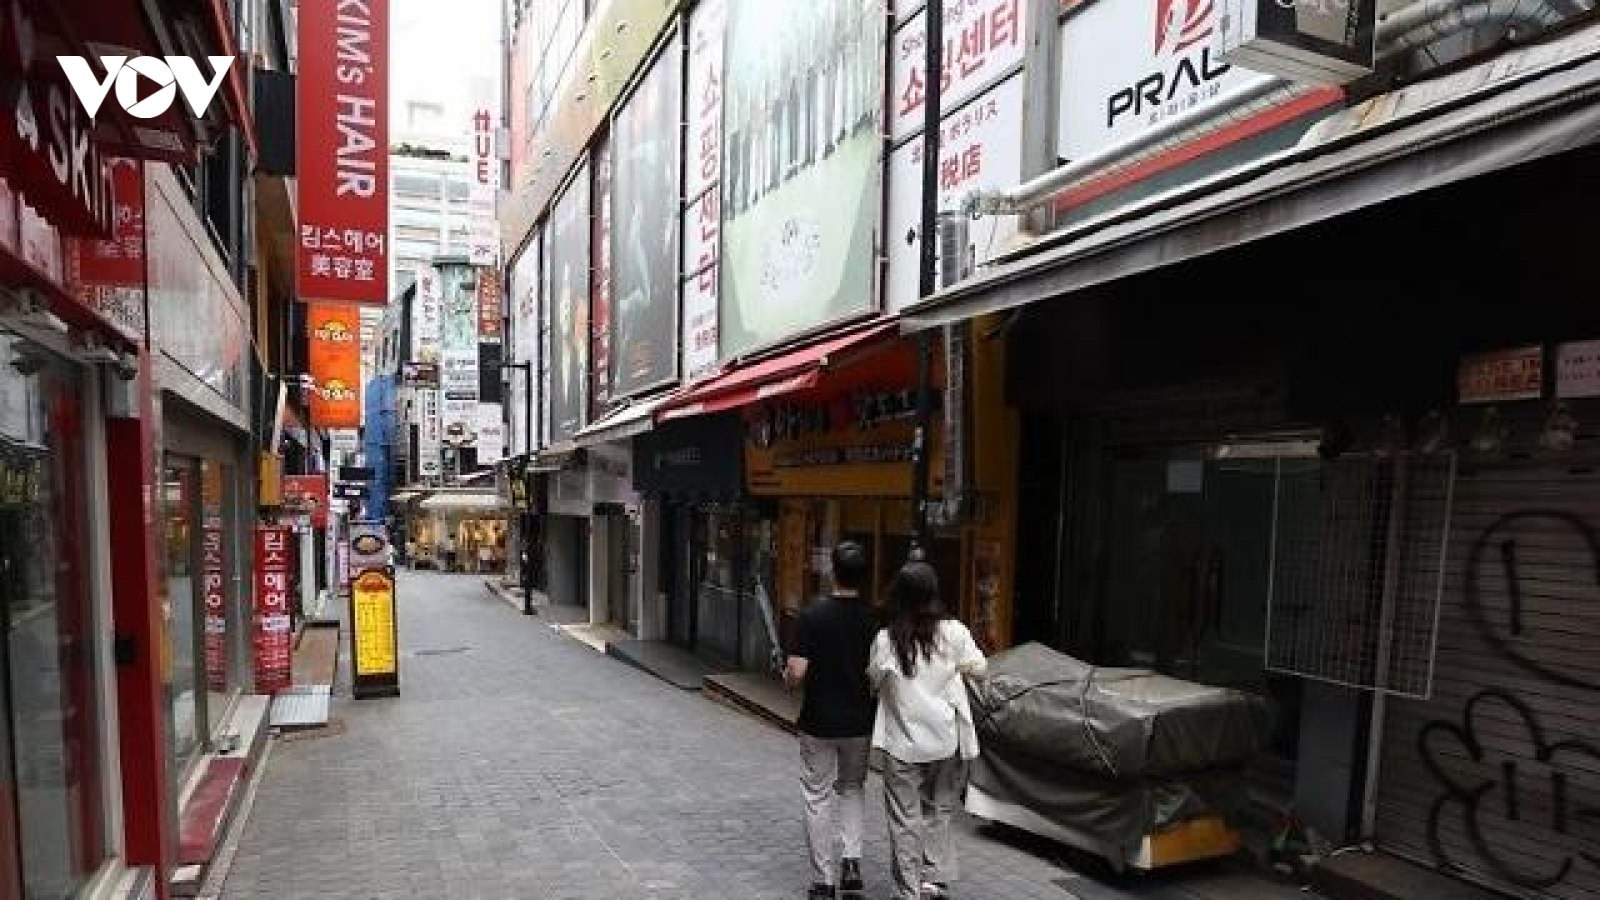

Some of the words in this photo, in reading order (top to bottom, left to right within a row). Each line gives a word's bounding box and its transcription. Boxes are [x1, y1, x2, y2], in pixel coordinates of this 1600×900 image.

[336, 94, 376, 198] HAIR
[700, 61, 722, 298] 쇼핑센터
[301, 224, 385, 255] 킴스헤어
[264, 530, 287, 611] 킴스헤어
